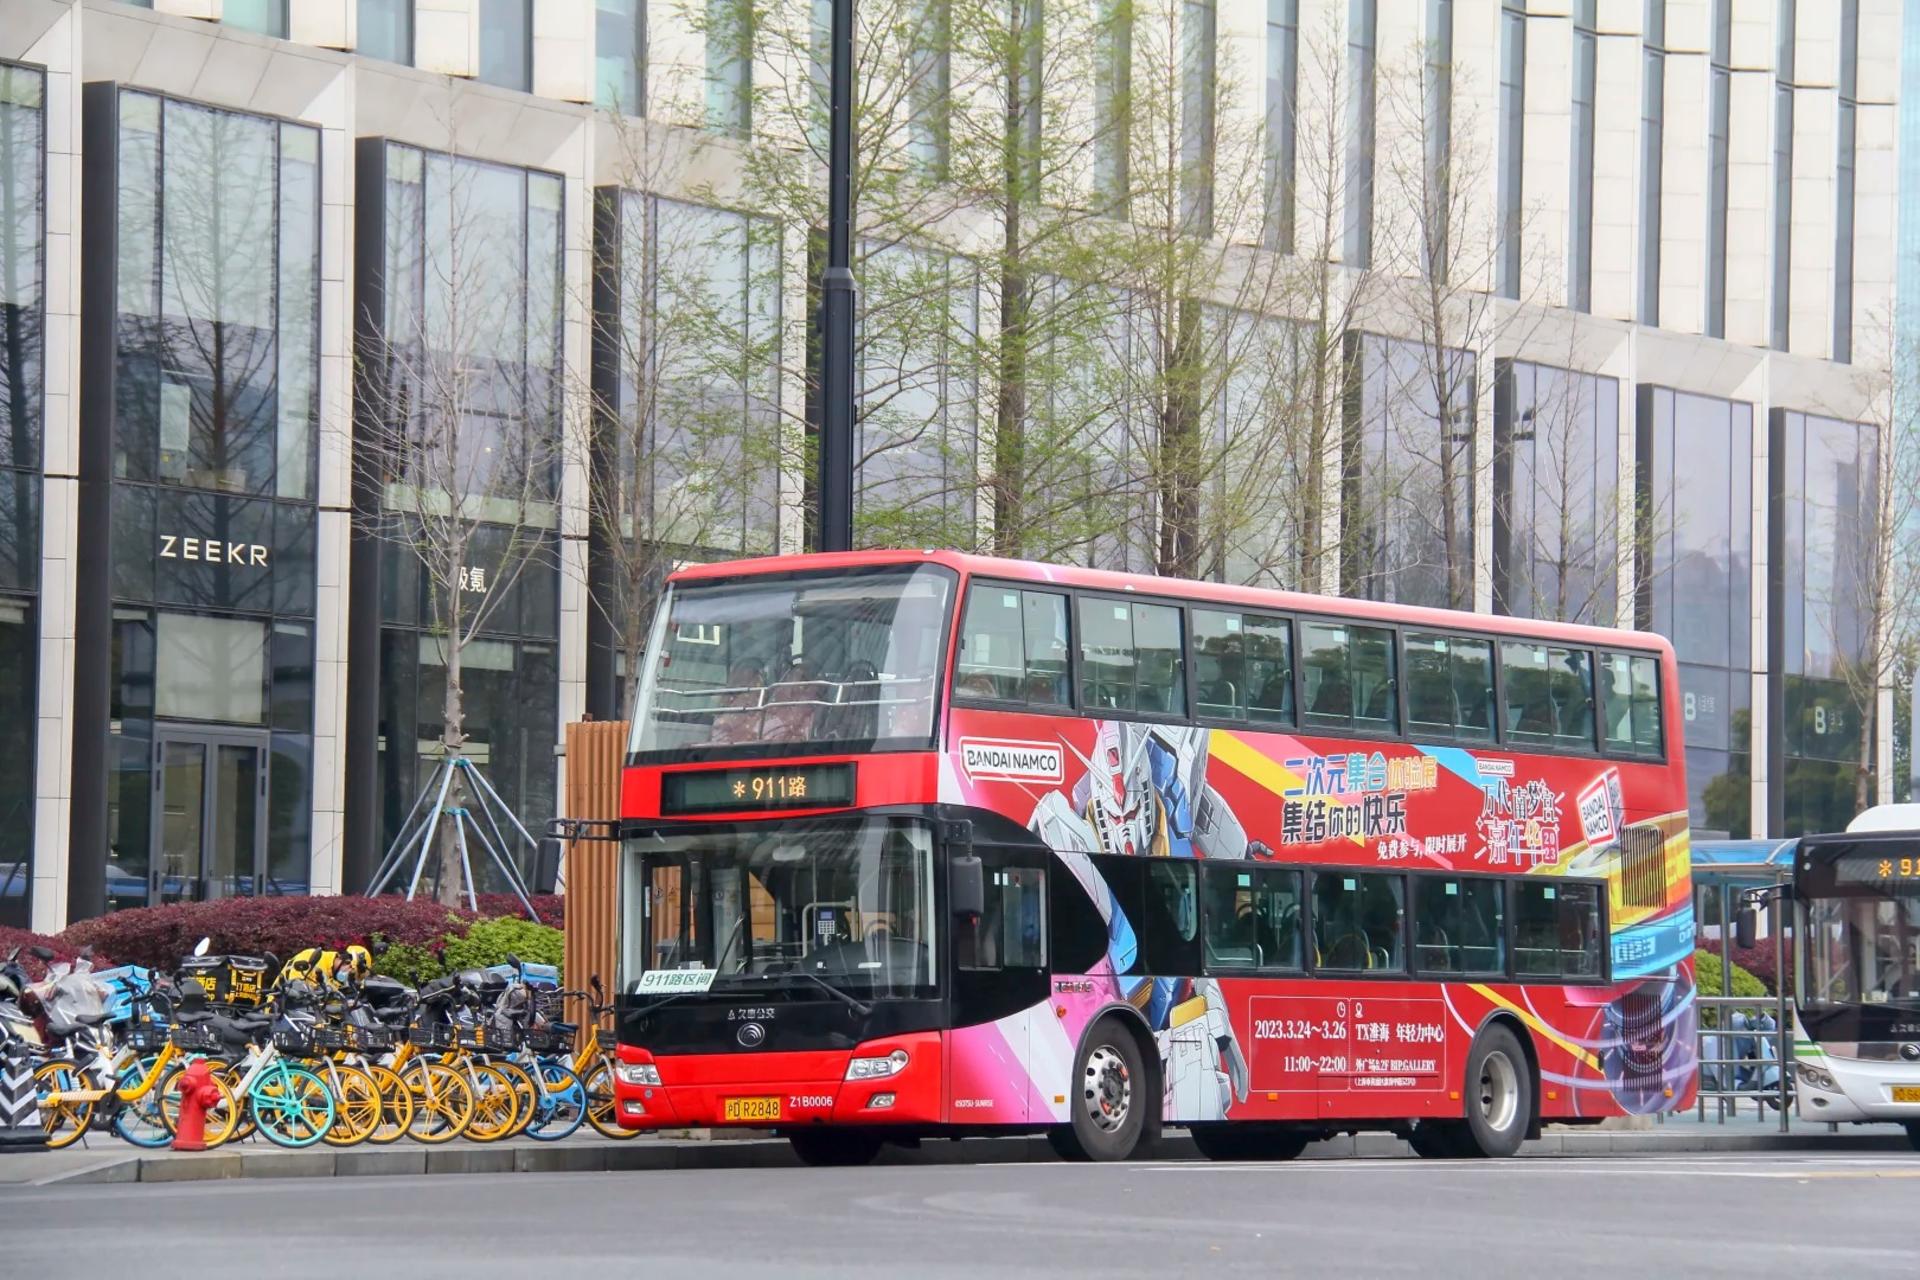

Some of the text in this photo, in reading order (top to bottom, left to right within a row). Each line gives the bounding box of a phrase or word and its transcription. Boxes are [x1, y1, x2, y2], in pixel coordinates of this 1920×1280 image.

[159, 534, 269, 568] ZEEKR
[967, 749, 1057, 771] BANDAI NAMCO
[1284, 751, 1438, 797] 二次元集合体验展
[752, 776, 807, 799] 911路
[1282, 793, 1407, 844] 集结你的快乐
[643, 972, 712, 986] 911路区间
[1396, 1022, 1444, 1043] 年轻力中心
[1284, 1055, 1346, 1072] 11:00~22:00
[743, 1101, 779, 1116] R2848
[790, 1096, 833, 1107] Z1B0006
